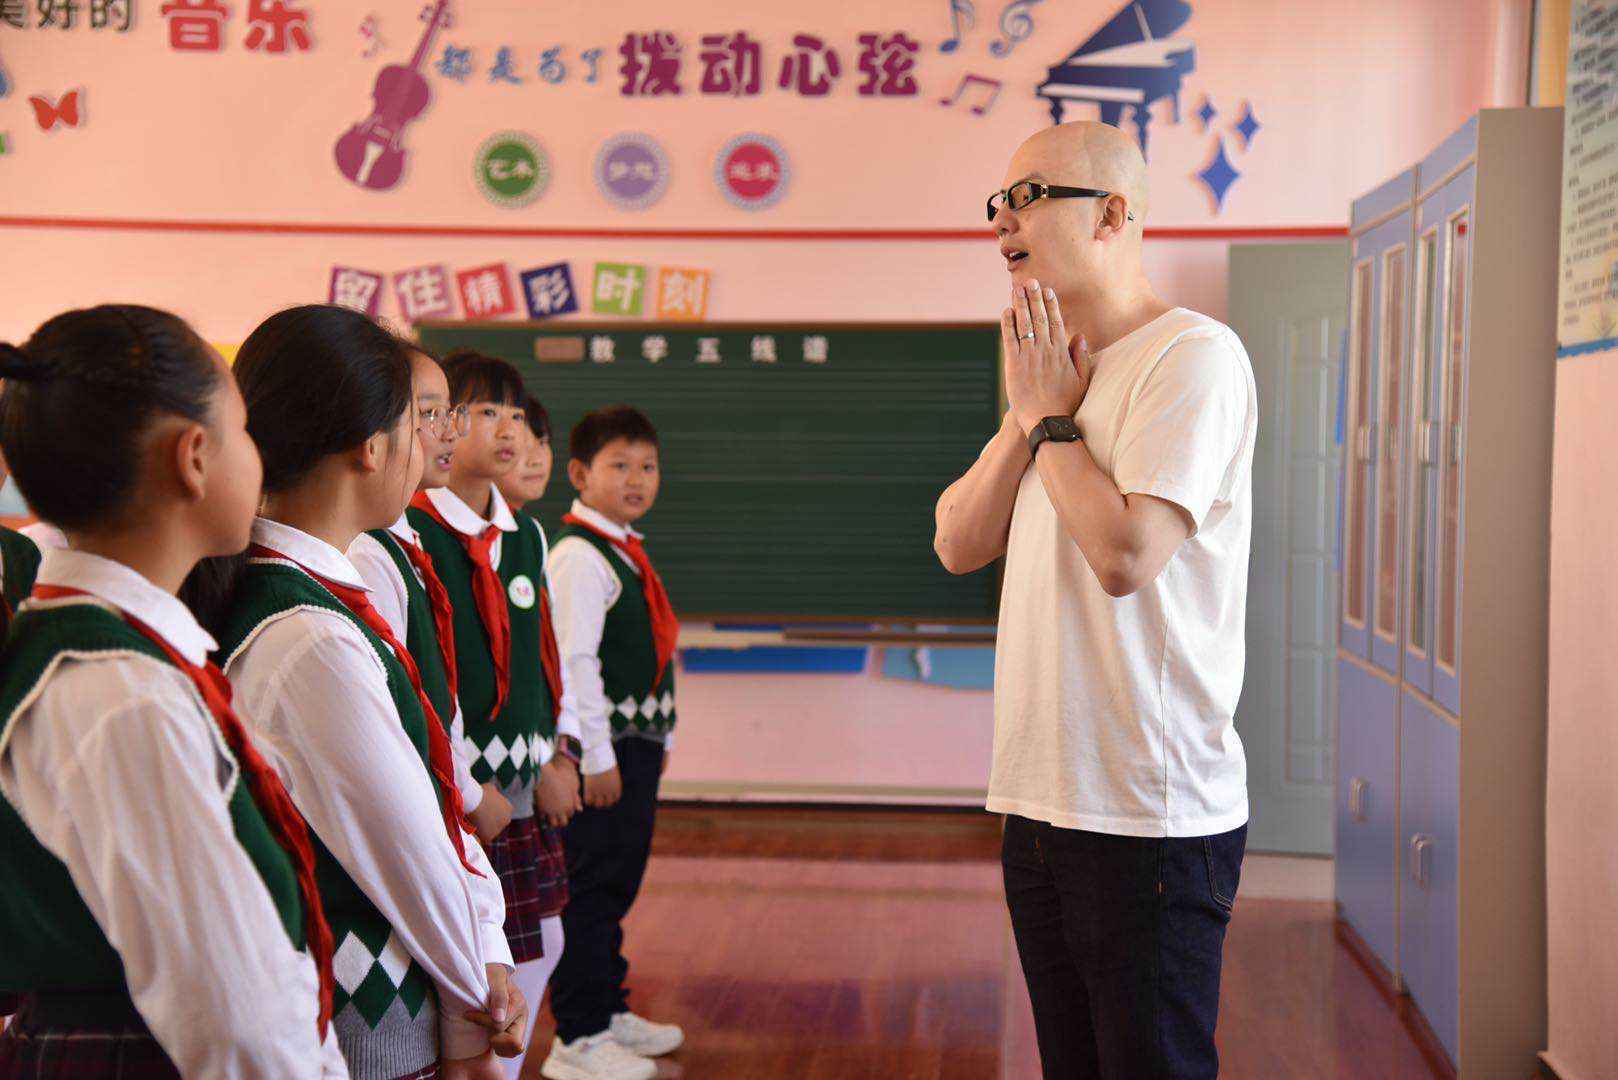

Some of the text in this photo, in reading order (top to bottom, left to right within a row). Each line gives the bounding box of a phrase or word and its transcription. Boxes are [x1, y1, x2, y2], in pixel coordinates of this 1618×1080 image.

[161, 0, 310, 52] 音乐
[620, 32, 919, 95] 拨动心弦
